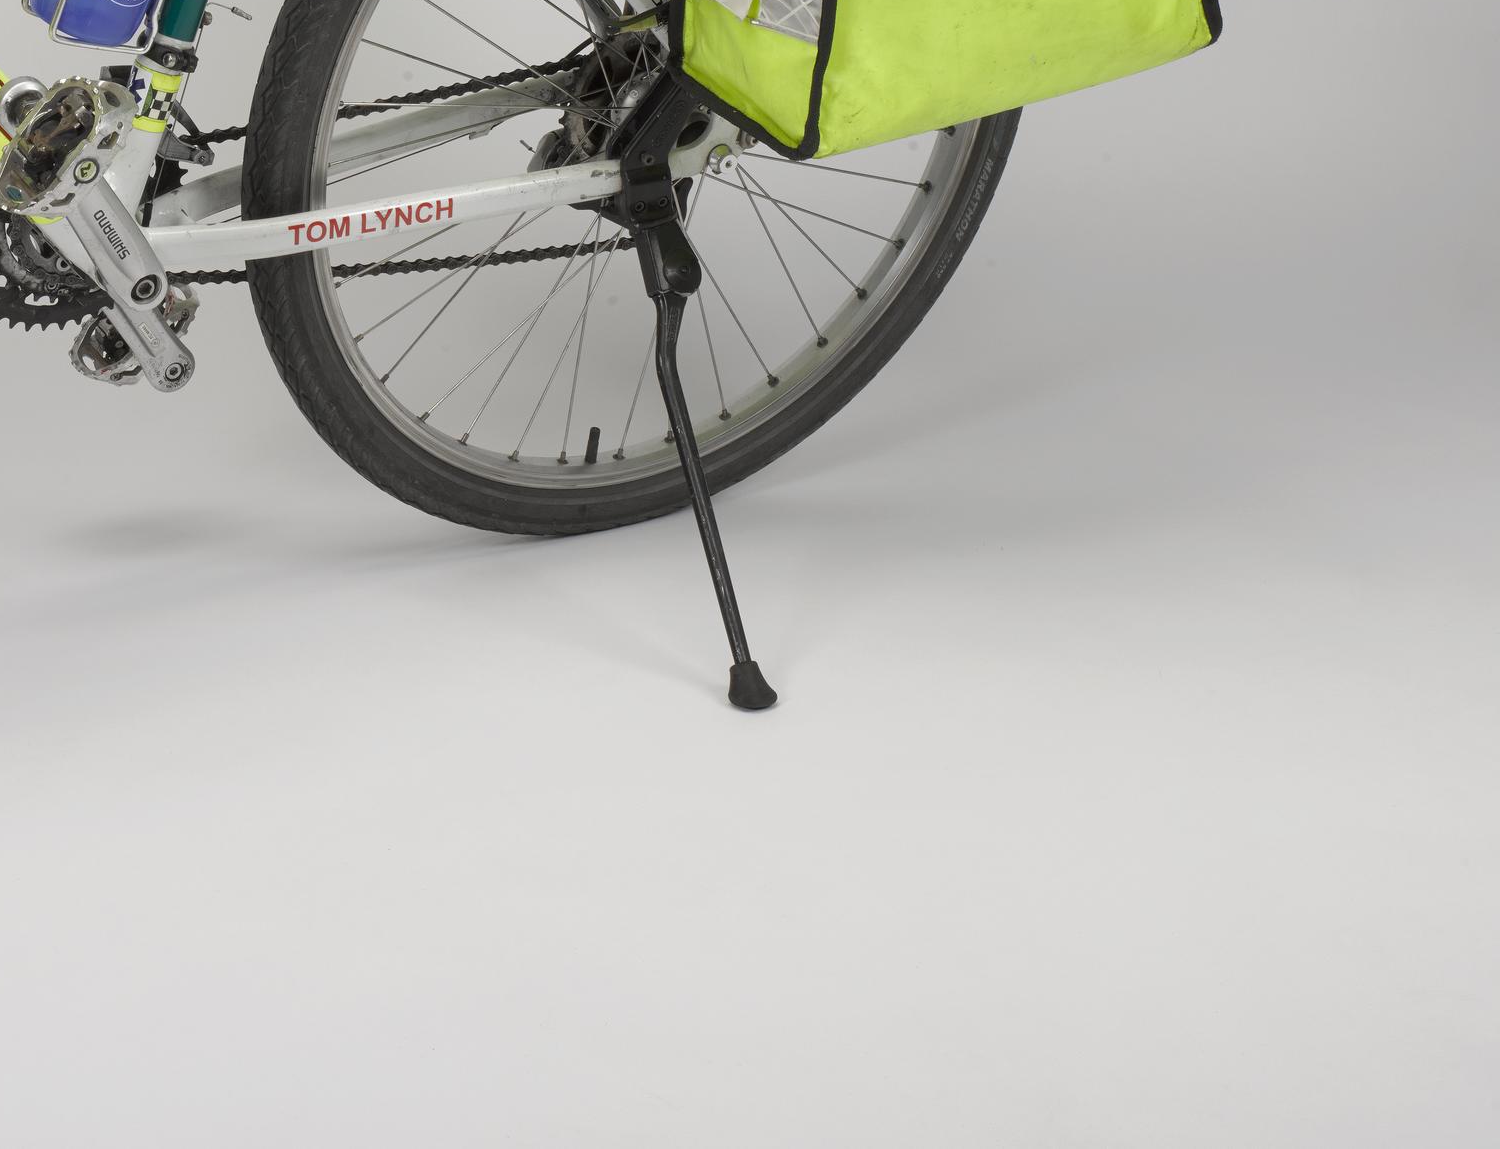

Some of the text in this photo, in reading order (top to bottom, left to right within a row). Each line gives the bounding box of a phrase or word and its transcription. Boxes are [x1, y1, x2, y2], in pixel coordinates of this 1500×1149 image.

[94, 209, 131, 261] SHIMANO
[287, 197, 454, 246] TOM LYNCH
